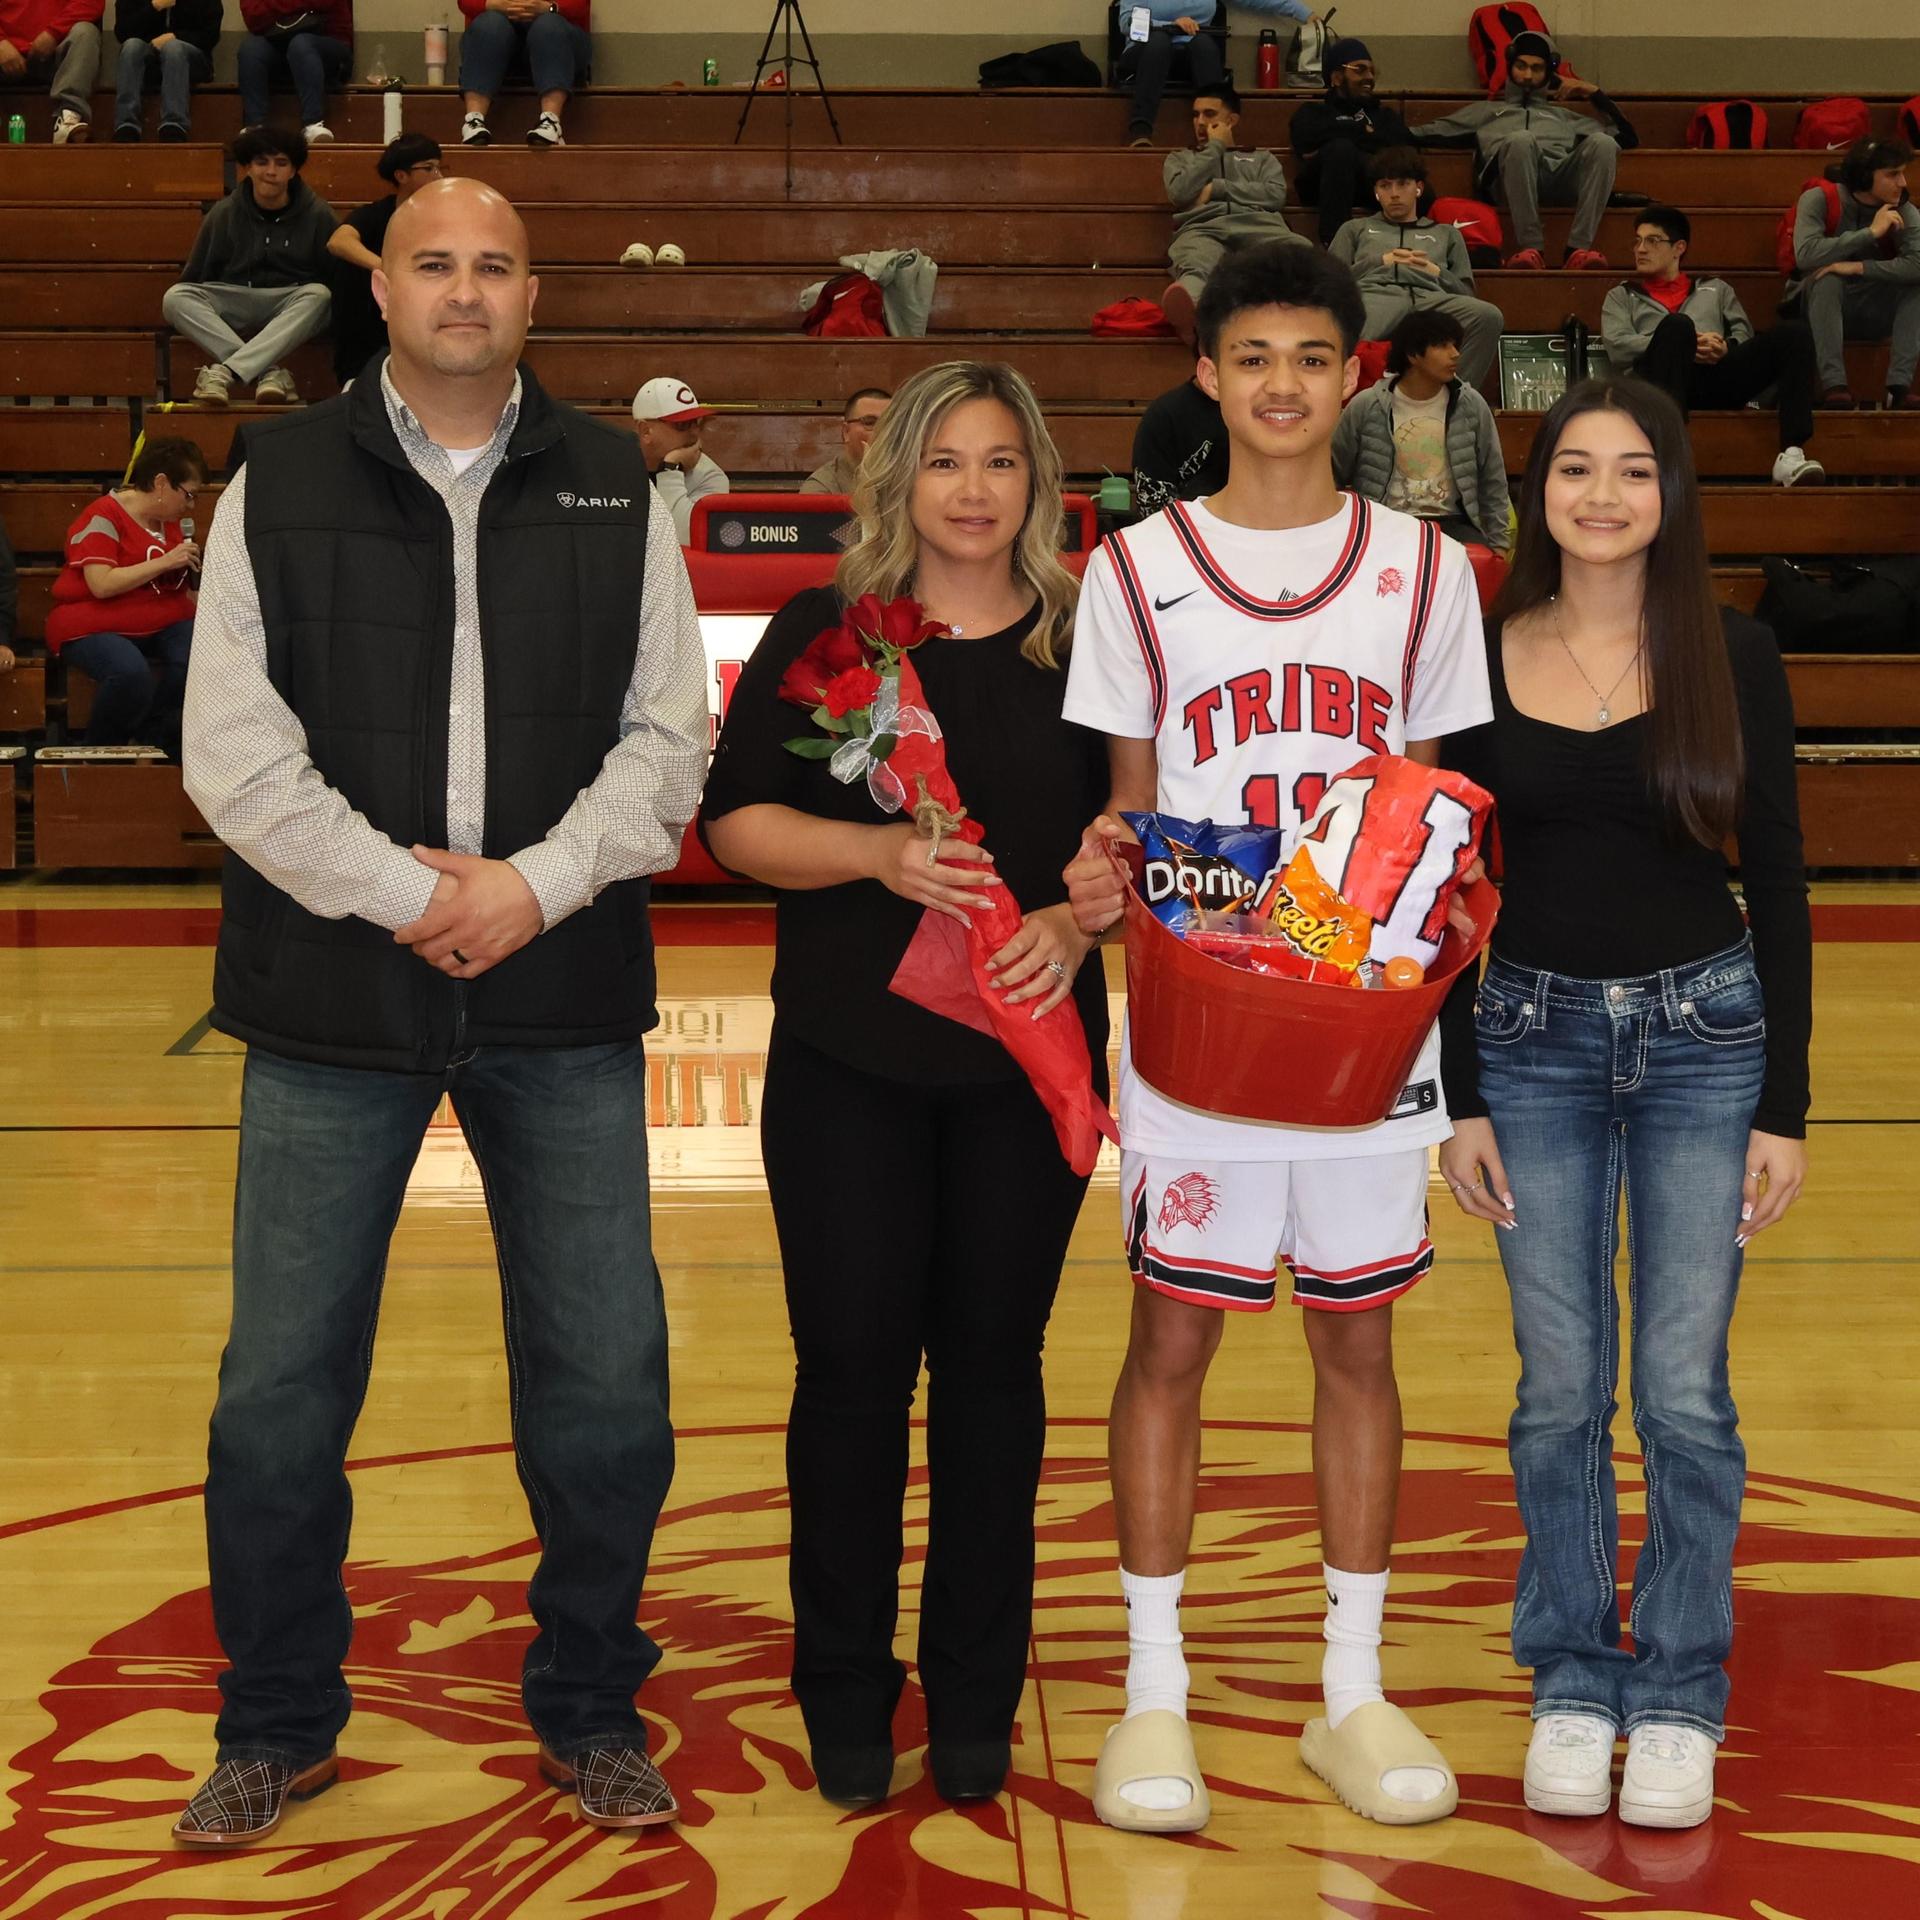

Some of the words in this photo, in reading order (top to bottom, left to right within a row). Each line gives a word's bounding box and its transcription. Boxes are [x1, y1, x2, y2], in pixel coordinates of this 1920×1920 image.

[676, 386, 695, 405] C
[576, 497, 631, 508] ARIAT
[750, 526, 799, 543] BONUS
[1182, 663, 1394, 768] TRIBE
[1423, 1089, 1432, 1103] S
